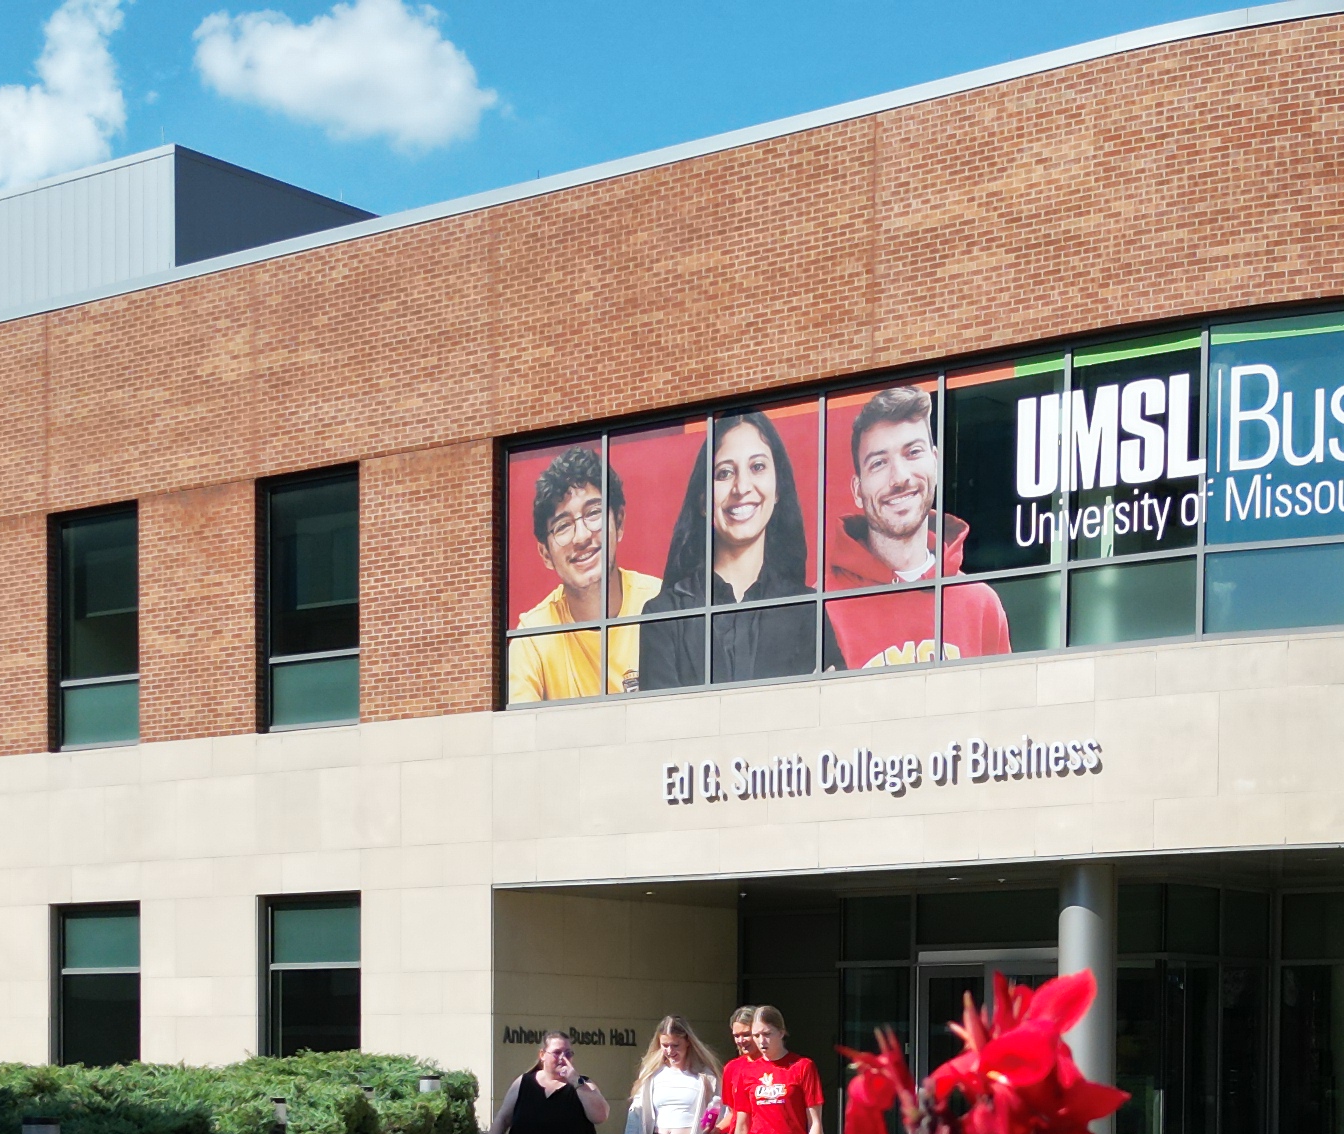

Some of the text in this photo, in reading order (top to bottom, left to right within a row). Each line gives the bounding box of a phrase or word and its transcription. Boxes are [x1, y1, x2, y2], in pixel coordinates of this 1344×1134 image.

[1017, 372, 1206, 498] UMSL
[1015, 488, 1172, 547] University
[1180, 479, 1214, 523] of
[662, 734, 1102, 801] Ed G. Smith College of Business
[609, 1028, 637, 1047] Hall
